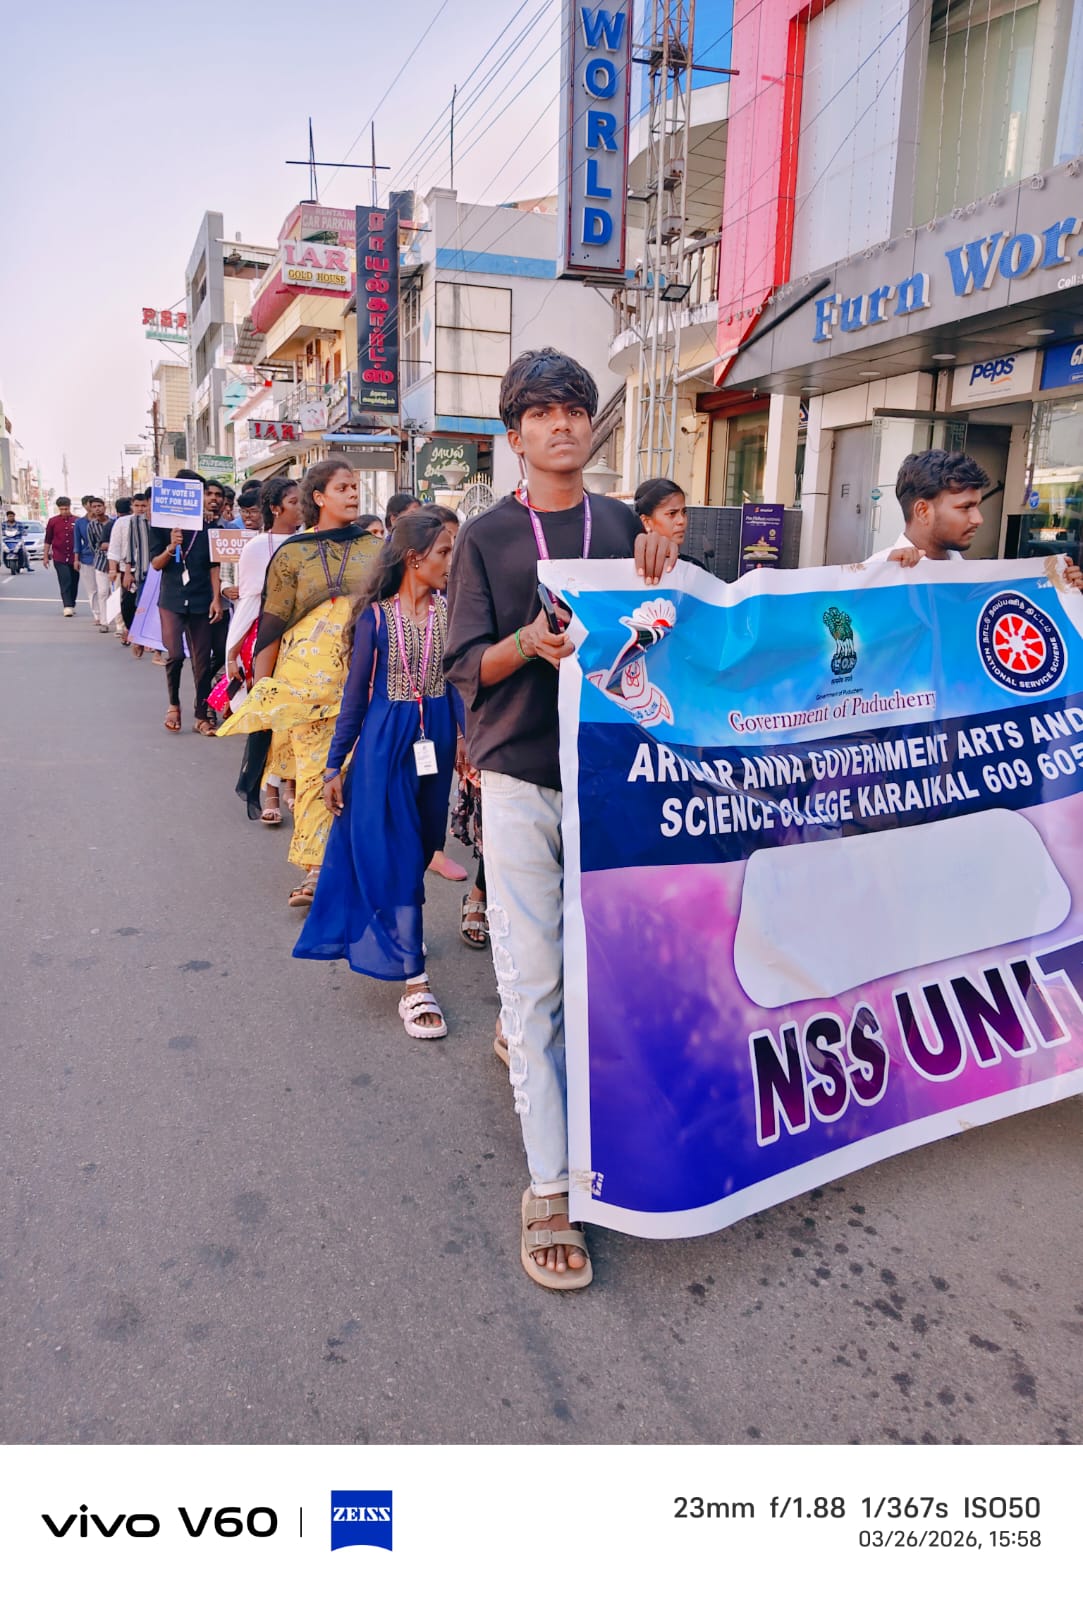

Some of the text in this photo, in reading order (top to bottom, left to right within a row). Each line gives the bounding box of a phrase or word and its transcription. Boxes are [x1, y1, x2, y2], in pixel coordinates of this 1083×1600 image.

[579, 7, 626, 246] WORLD
[303, 215, 356, 231] CAR PARKIN
[284, 244, 348, 271] IAR
[288, 269, 346, 286] GOLD HOUSE
[812, 216, 1083, 343] Furn Wor
[968, 355, 1016, 387] peps
[254, 422, 296, 439] IAR
[155, 496, 198, 507] NOT FOR SALE
[161, 488, 171, 496] MY
[172, 489, 188, 497] VOTE
[216, 538, 248, 547] GO OUT
[984, 636, 1060, 688] NATIONAL SERVICE SCHEME
[730, 707, 829, 732] Government
[833, 699, 850, 718] of
[741, 754, 806, 790] ANNA
[808, 733, 948, 781] GOVERNMENT
[957, 720, 1024, 760] ARTS
[1029, 707, 1083, 744] AND
[660, 795, 774, 838] SCIENCE
[858, 771, 980, 818] KARAIKAL
[983, 758, 1033, 793] 609
[1037, 742, 1083, 780] 605
[749, 936, 1083, 1147] NSS UNIT
